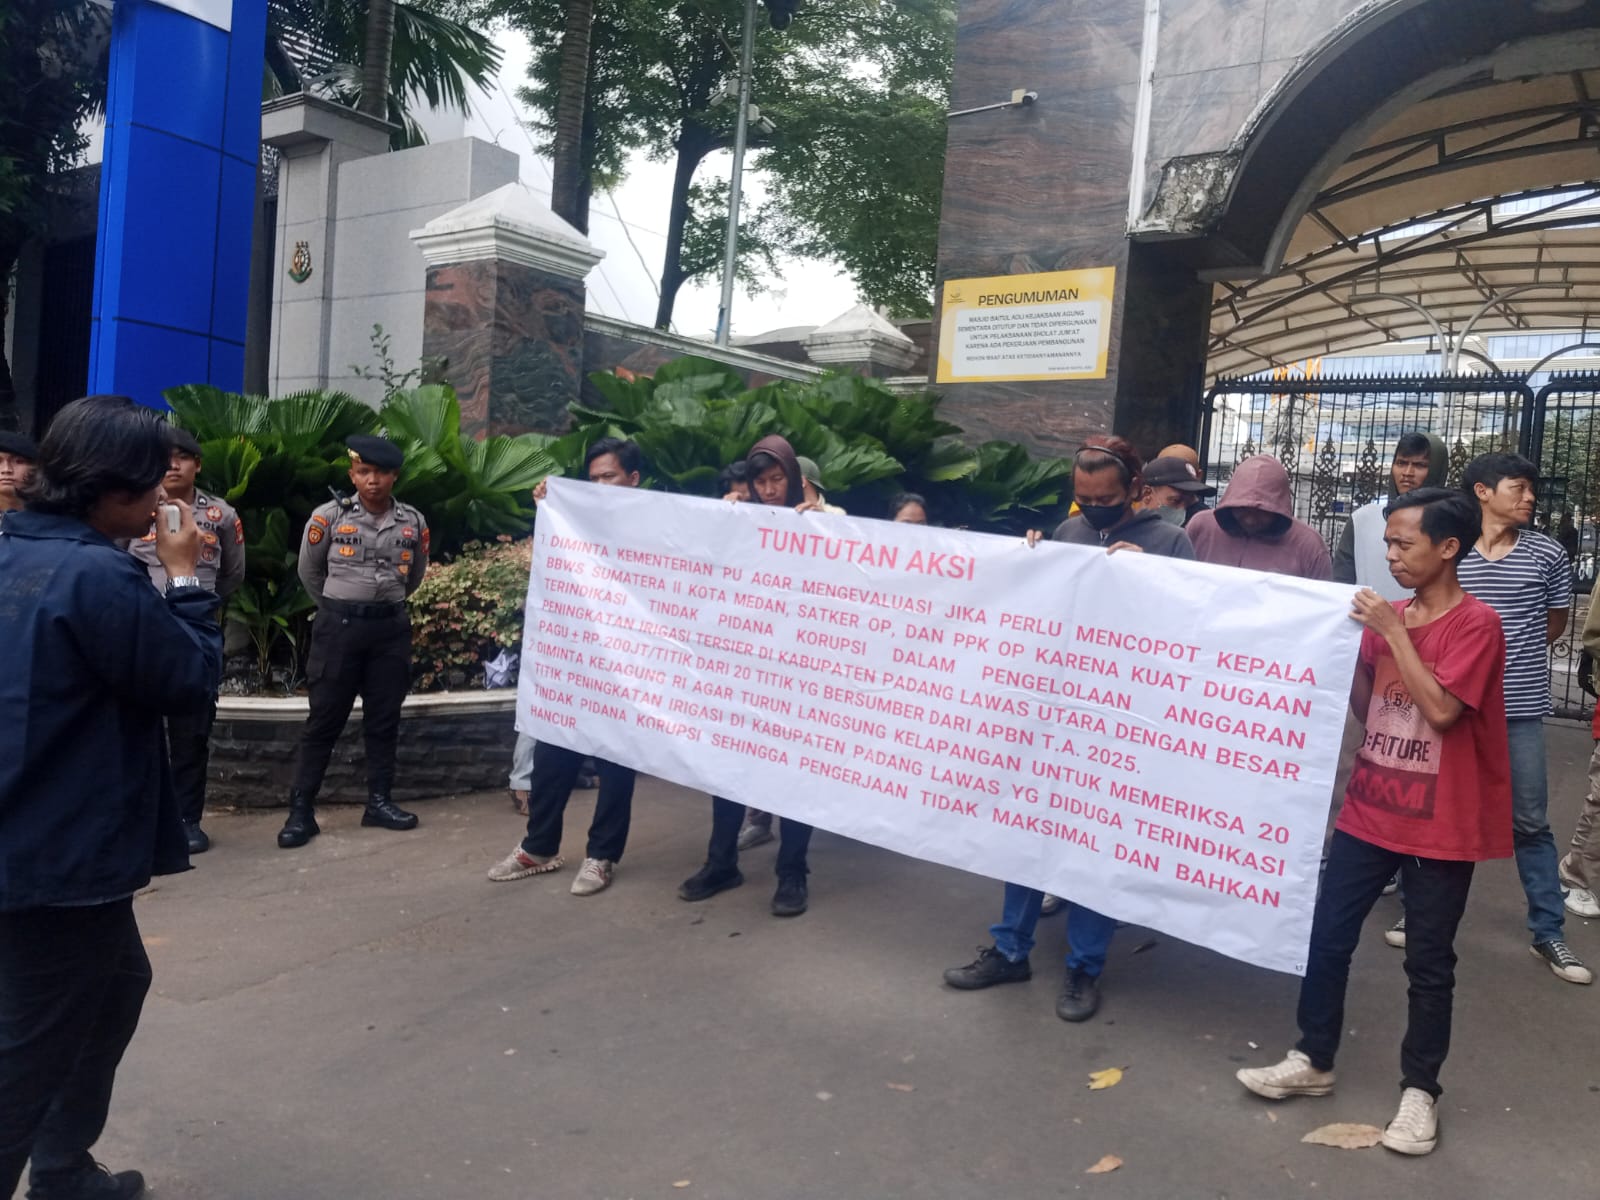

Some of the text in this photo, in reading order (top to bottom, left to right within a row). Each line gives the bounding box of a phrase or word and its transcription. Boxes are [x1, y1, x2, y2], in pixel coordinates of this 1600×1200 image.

[978, 288, 1079, 306] PENGUMUMAN
[550, 535, 608, 556] DIMINTA
[617, 548, 713, 576] KEMENTERIAN
[723, 566, 743, 581] PU
[752, 572, 792, 588] AGAR
[802, 579, 933, 614] MENGEVALUASI
[945, 604, 987, 624] JIKA
[999, 612, 1063, 637] PERLU
[1075, 624, 1200, 662] MENCOPOT
[1217, 650, 1317, 686] KEPALA
[757, 527, 976, 581] TUNTUTAN AKSI
[531, 706, 576, 728] HANCUR
[538, 620, 568, 636] PAGU
[697, 656, 729, 672] DARI
[735, 666, 750, 679] 20
[757, 670, 792, 688] TITIK
[800, 680, 818, 696] YG
[824, 685, 924, 720] BERSUMBER
[929, 710, 972, 732] DARI
[977, 722, 1035, 746] APBN
[1042, 733, 1080, 757] T.A.
[1087, 744, 1140, 774] 2025.
[543, 599, 1302, 782] PENINGKATAN IRIGASI TERSIER DI KABUPATEN PADANG LAWAS UTARA DENGAN BESAR
[544, 578, 1307, 750] TERINDIKASI TINDAK PIDANA KORUPSI DALAM PENGELOLAAN ANGGARAN
[547, 556, 584, 575] BBWS
[592, 566, 665, 591] SUMATERA
[688, 585, 726, 601] KOTA
[734, 592, 789, 616] MEDAN,
[799, 604, 859, 626] SATKER
[868, 617, 894, 637] OP,
[905, 624, 944, 644] DAN
[953, 632, 989, 653] PPK
[998, 641, 1025, 657] OP
[1035, 647, 1119, 678] KARENA
[1131, 665, 1192, 692] KUAT
[1203, 680, 1312, 718] DUGAAN
[534, 684, 1281, 908] TINDAK PIDANA KORUPSI SEHINGGA PENGERJAAN TIDAK MAKSIMAL DAN BAHKAN
[536, 662, 1286, 877] TITIK PENINGKATAN IRIGASI DI KABUPATEN PADANG LAWAS YG DIDUGA TERINDIKASI
[537, 641, 584, 664] DIMINTA
[589, 656, 666, 684] KEJAGUNG
[672, 674, 686, 688] RI
[694, 681, 732, 698] AGAR
[743, 690, 792, 714] TURUN
[798, 705, 885, 738] LANGSUNG
[895, 729, 1022, 772] KELAPANGAN
[1032, 759, 1101, 791] UNTUK
[1109, 780, 1245, 835] MEMERIKSA
[1258, 822, 1290, 844] 20
